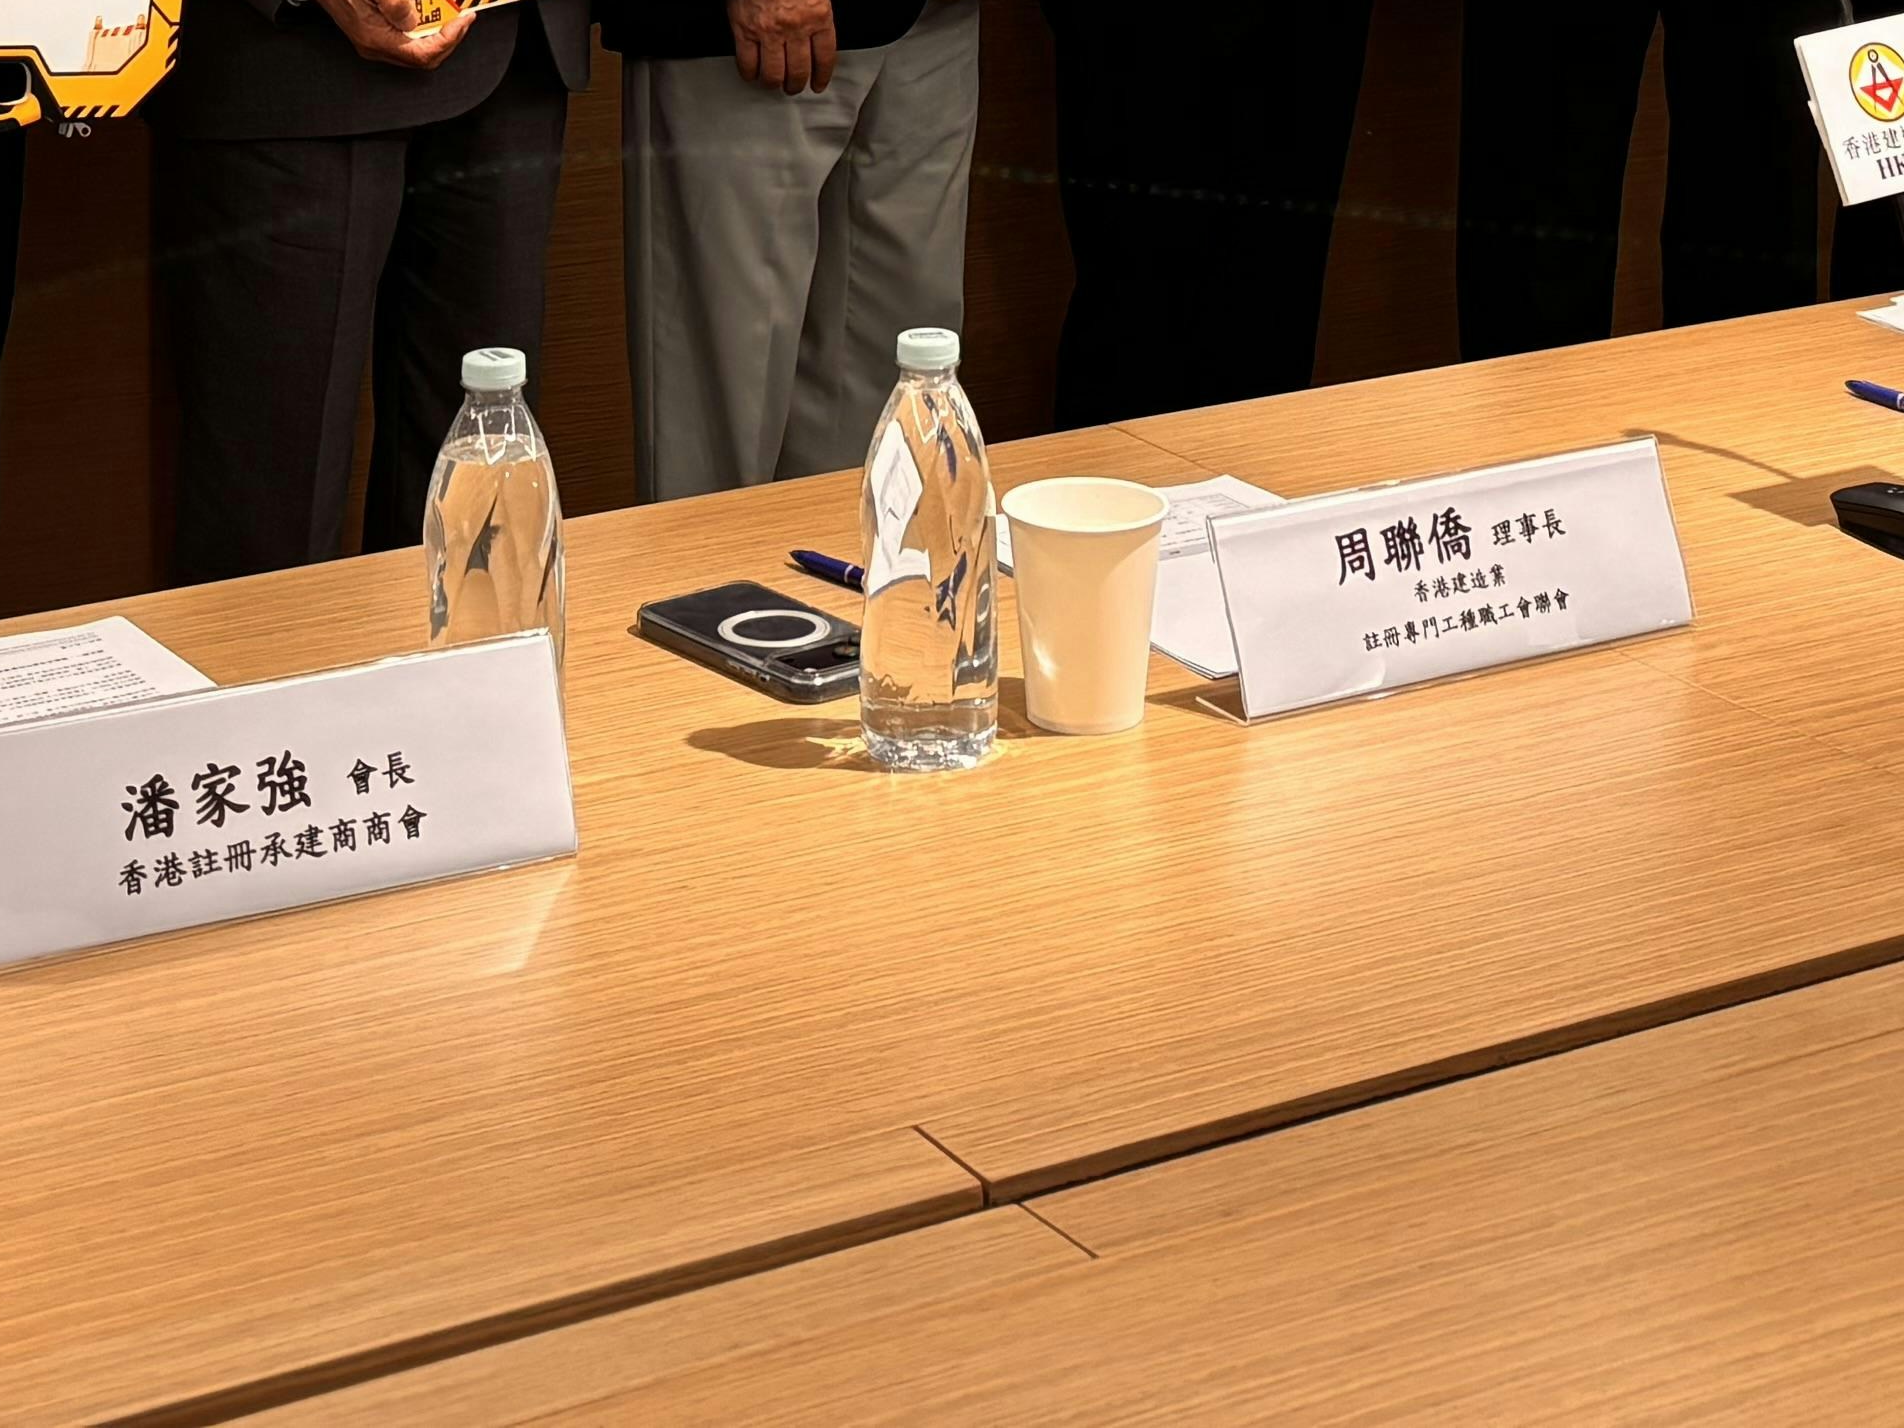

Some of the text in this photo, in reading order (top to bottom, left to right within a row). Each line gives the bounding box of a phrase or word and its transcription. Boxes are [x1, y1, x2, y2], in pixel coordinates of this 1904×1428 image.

[1335, 507, 1567, 586] 周聯僑 理事長
[1414, 564, 1506, 603] 香港建造業
[1363, 588, 1570, 653] 註冊專門工種職工會聯會
[121, 750, 416, 842] 潘家強 會長
[118, 803, 428, 897] 香港註冊承建商商會
